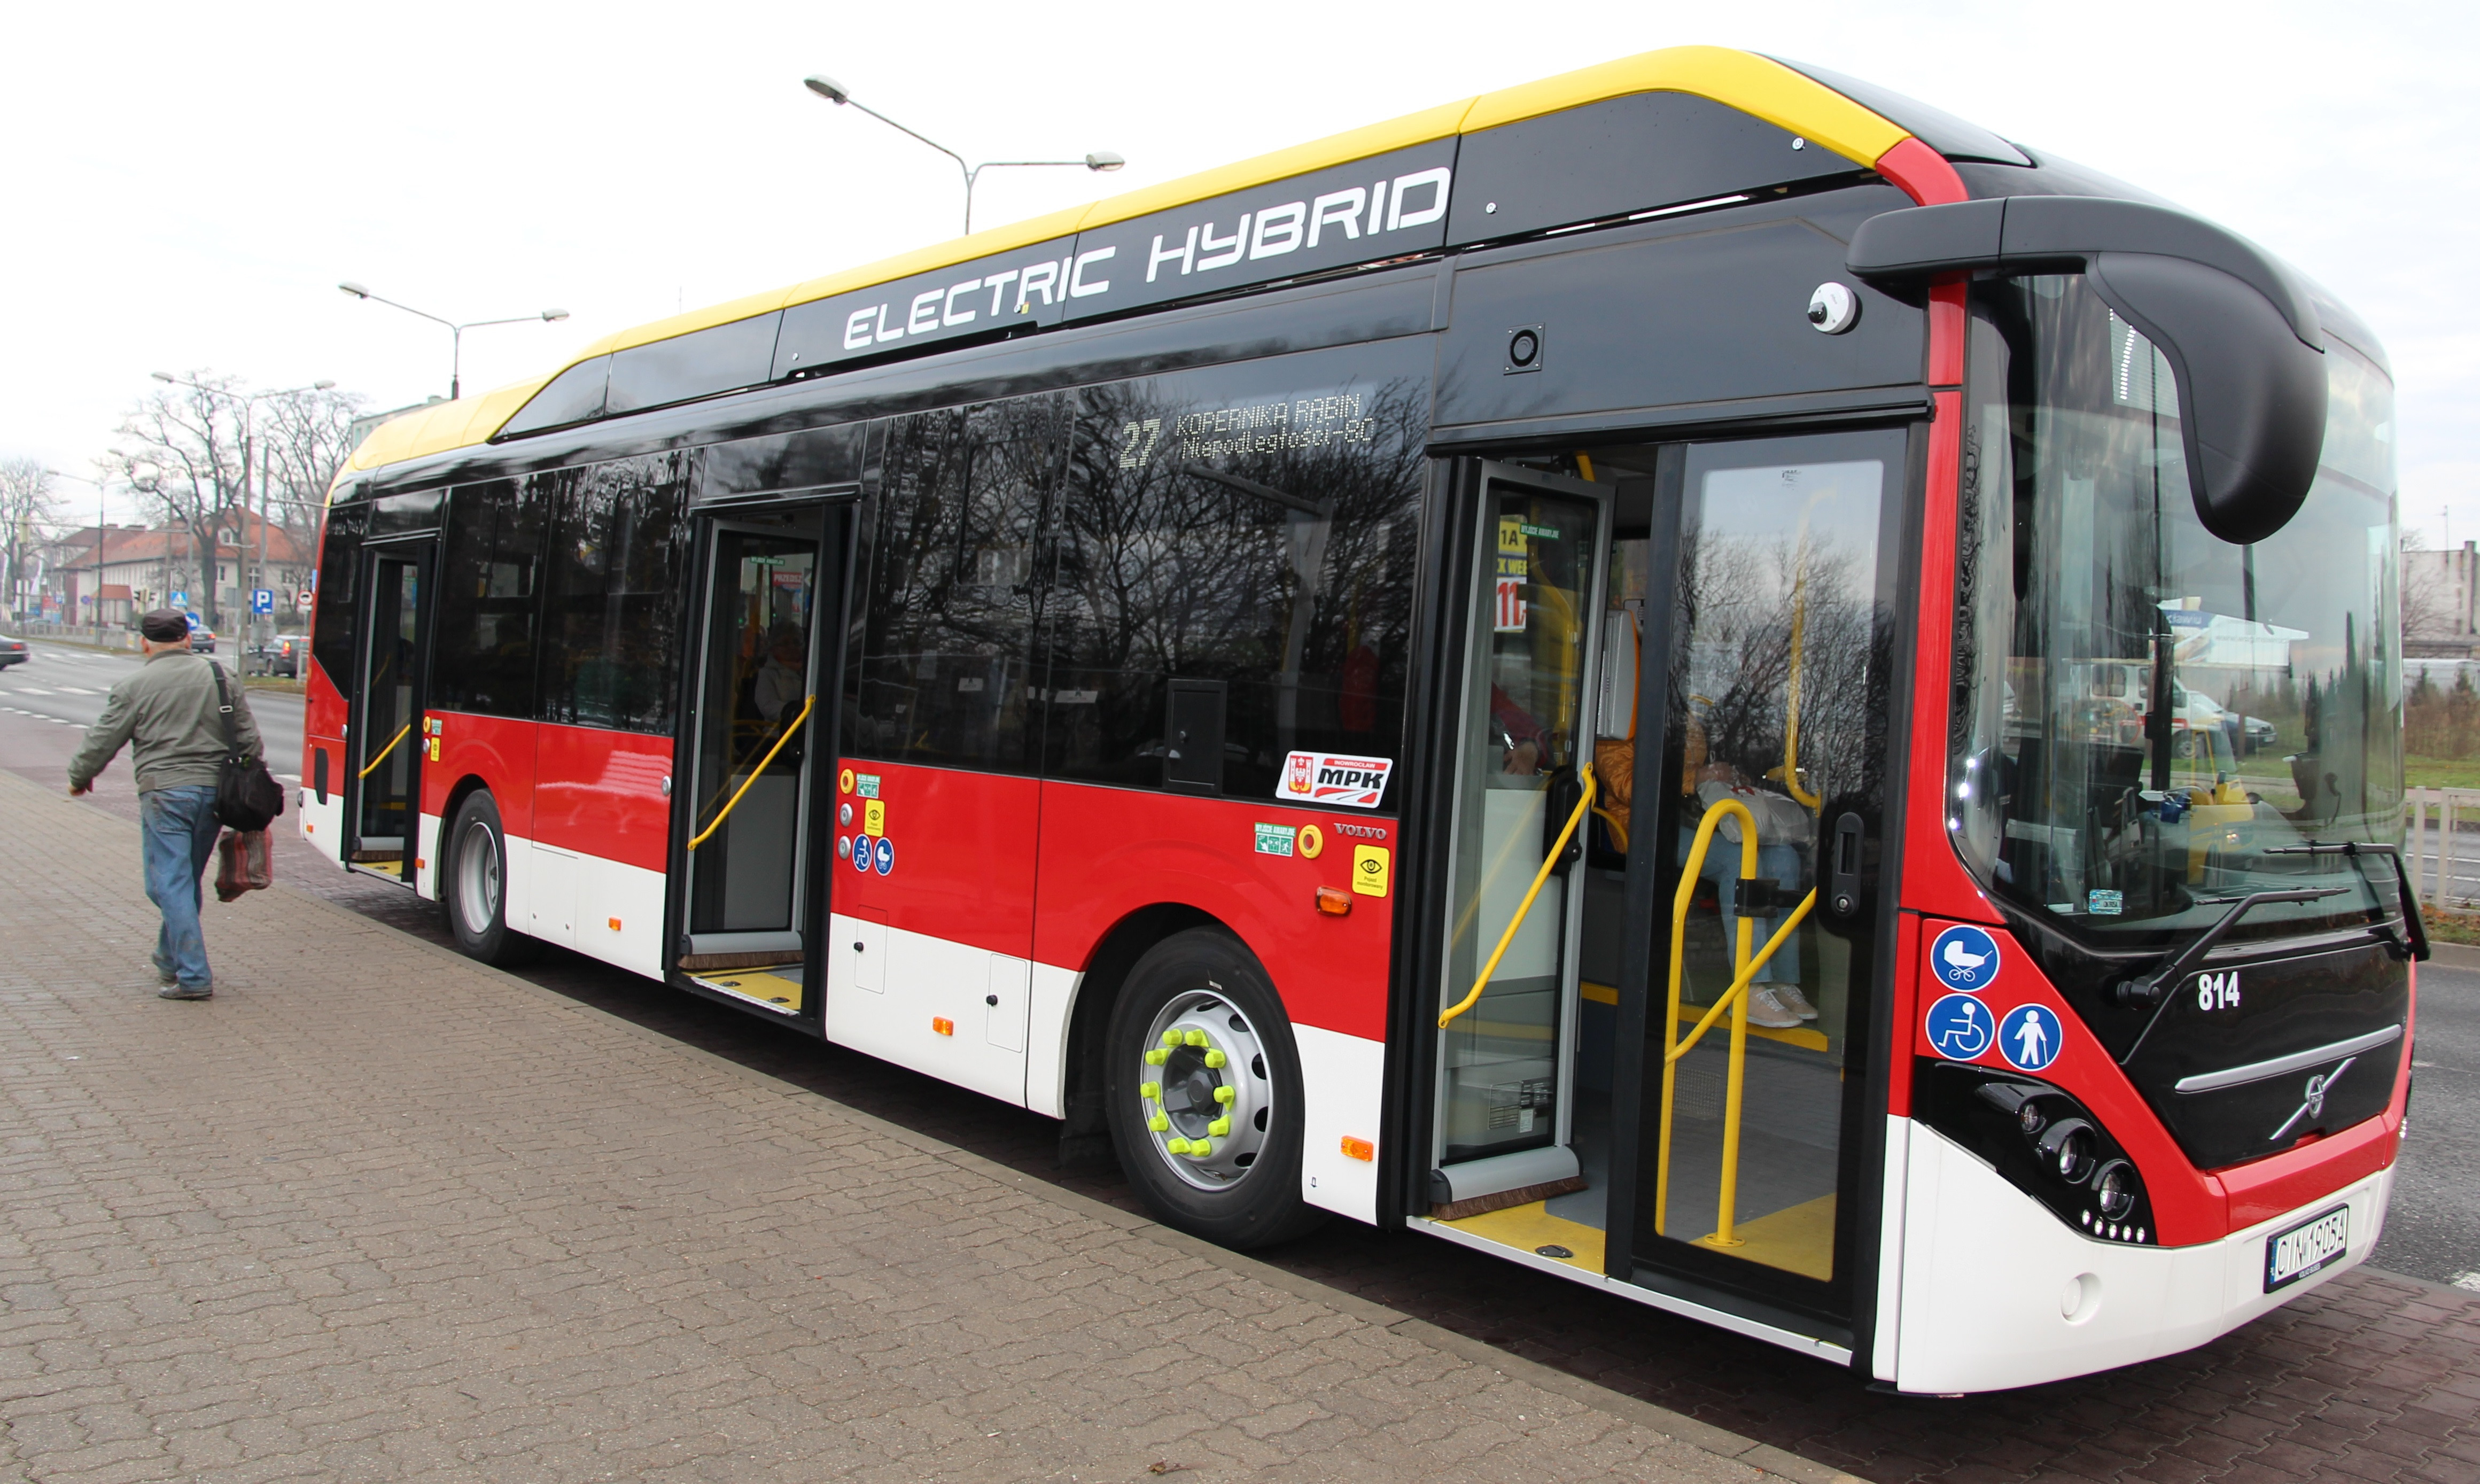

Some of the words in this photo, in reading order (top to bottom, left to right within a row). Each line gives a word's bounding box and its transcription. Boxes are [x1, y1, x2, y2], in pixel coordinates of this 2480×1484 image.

[843, 245, 1116, 350] ELECTRIC
[1146, 166, 1451, 282] HYBRID
[1176, 402, 1288, 437] KOPERNIKA
[1120, 417, 1161, 468] 27
[256, 591, 270, 608] P
[1318, 768, 1384, 789] MPK
[1334, 822, 1387, 840] VOLVO
[2198, 971, 2240, 1011] 814
